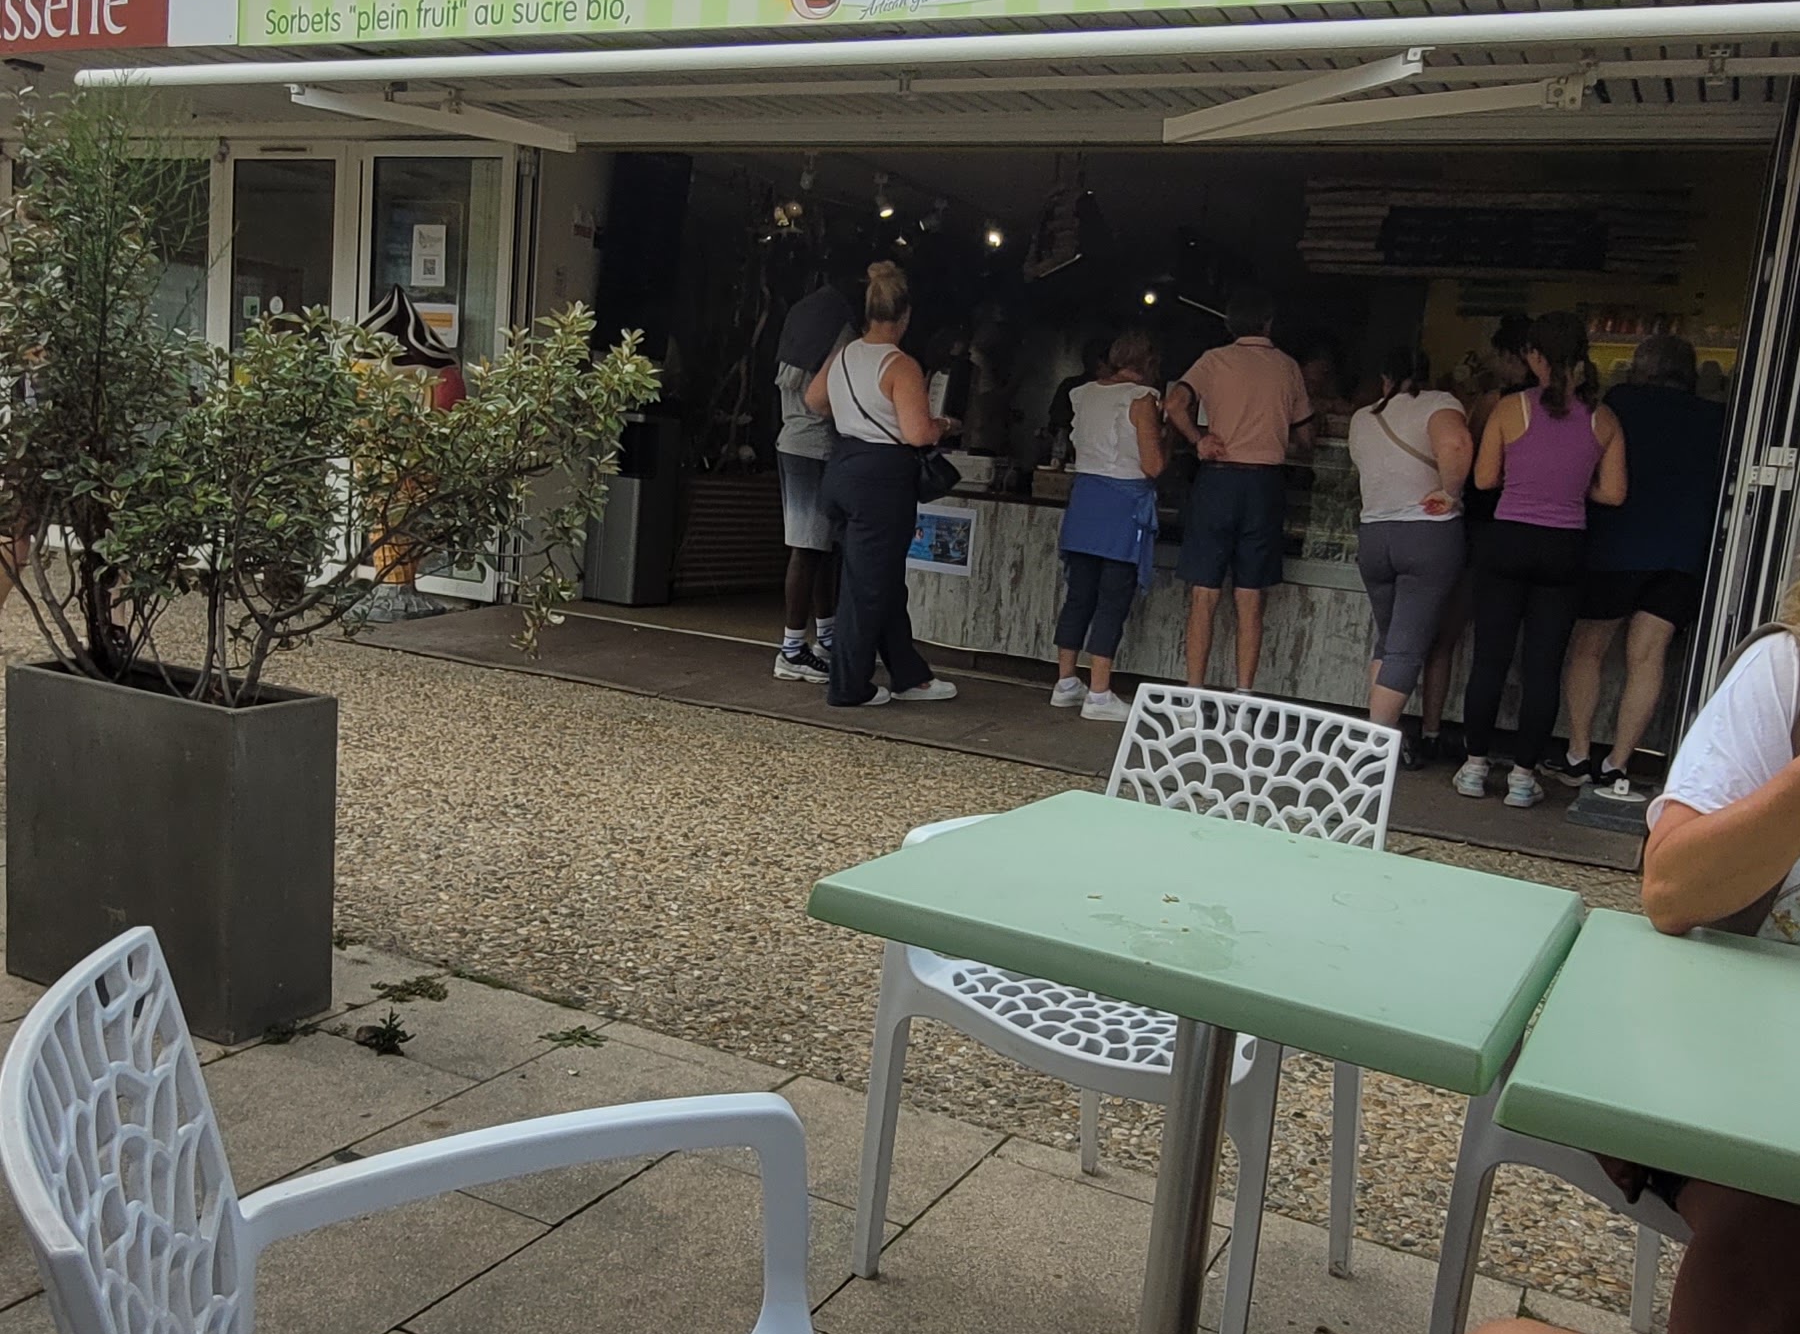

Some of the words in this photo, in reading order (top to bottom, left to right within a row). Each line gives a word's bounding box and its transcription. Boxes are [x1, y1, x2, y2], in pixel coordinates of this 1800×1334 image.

[265, 6, 341, 35] Sorbets
[349, 1, 409, 39] "plein
[474, 3, 504, 26] au
[511, 0, 578, 24] sucre
